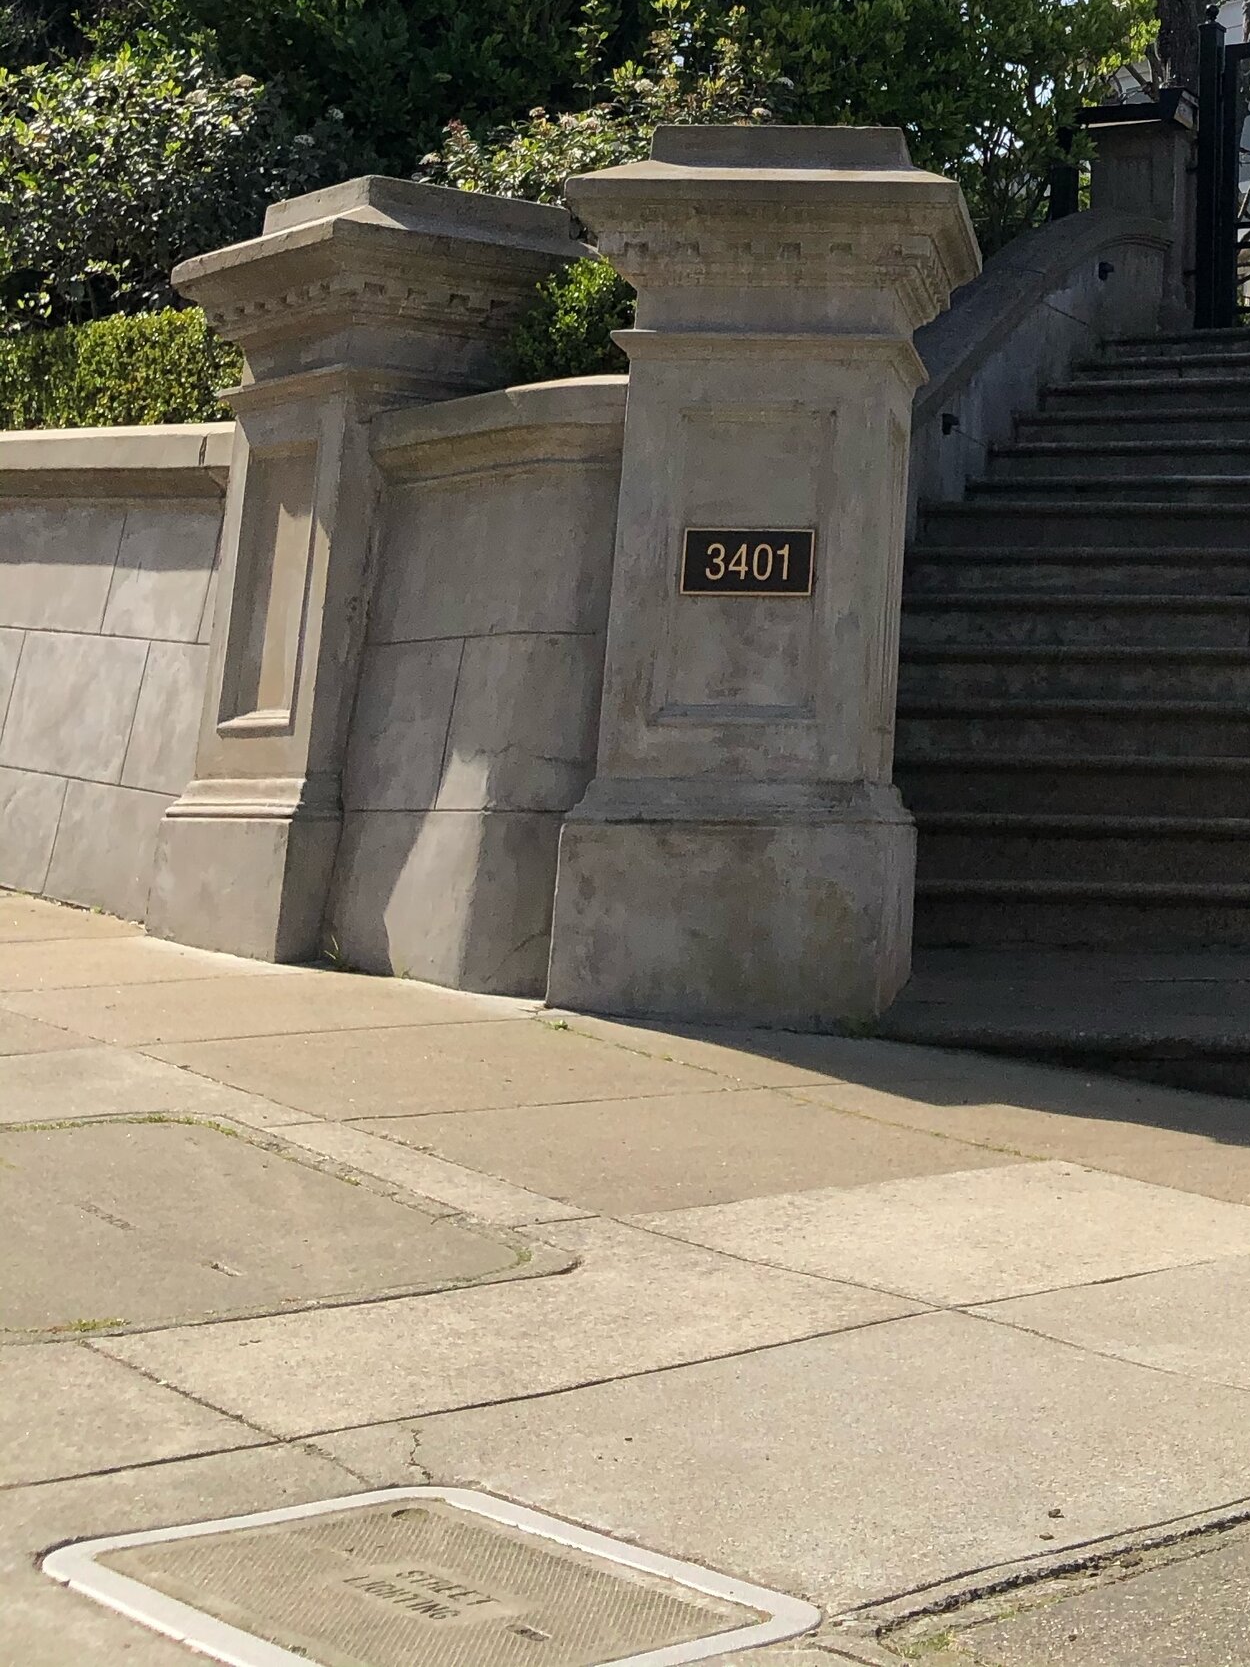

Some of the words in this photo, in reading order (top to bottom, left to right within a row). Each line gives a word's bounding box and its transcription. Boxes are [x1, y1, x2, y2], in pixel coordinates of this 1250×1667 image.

[705, 543, 790, 581] 3401
[342, 1573, 461, 1620] LIGHTING
[395, 1569, 501, 1606] STREET
